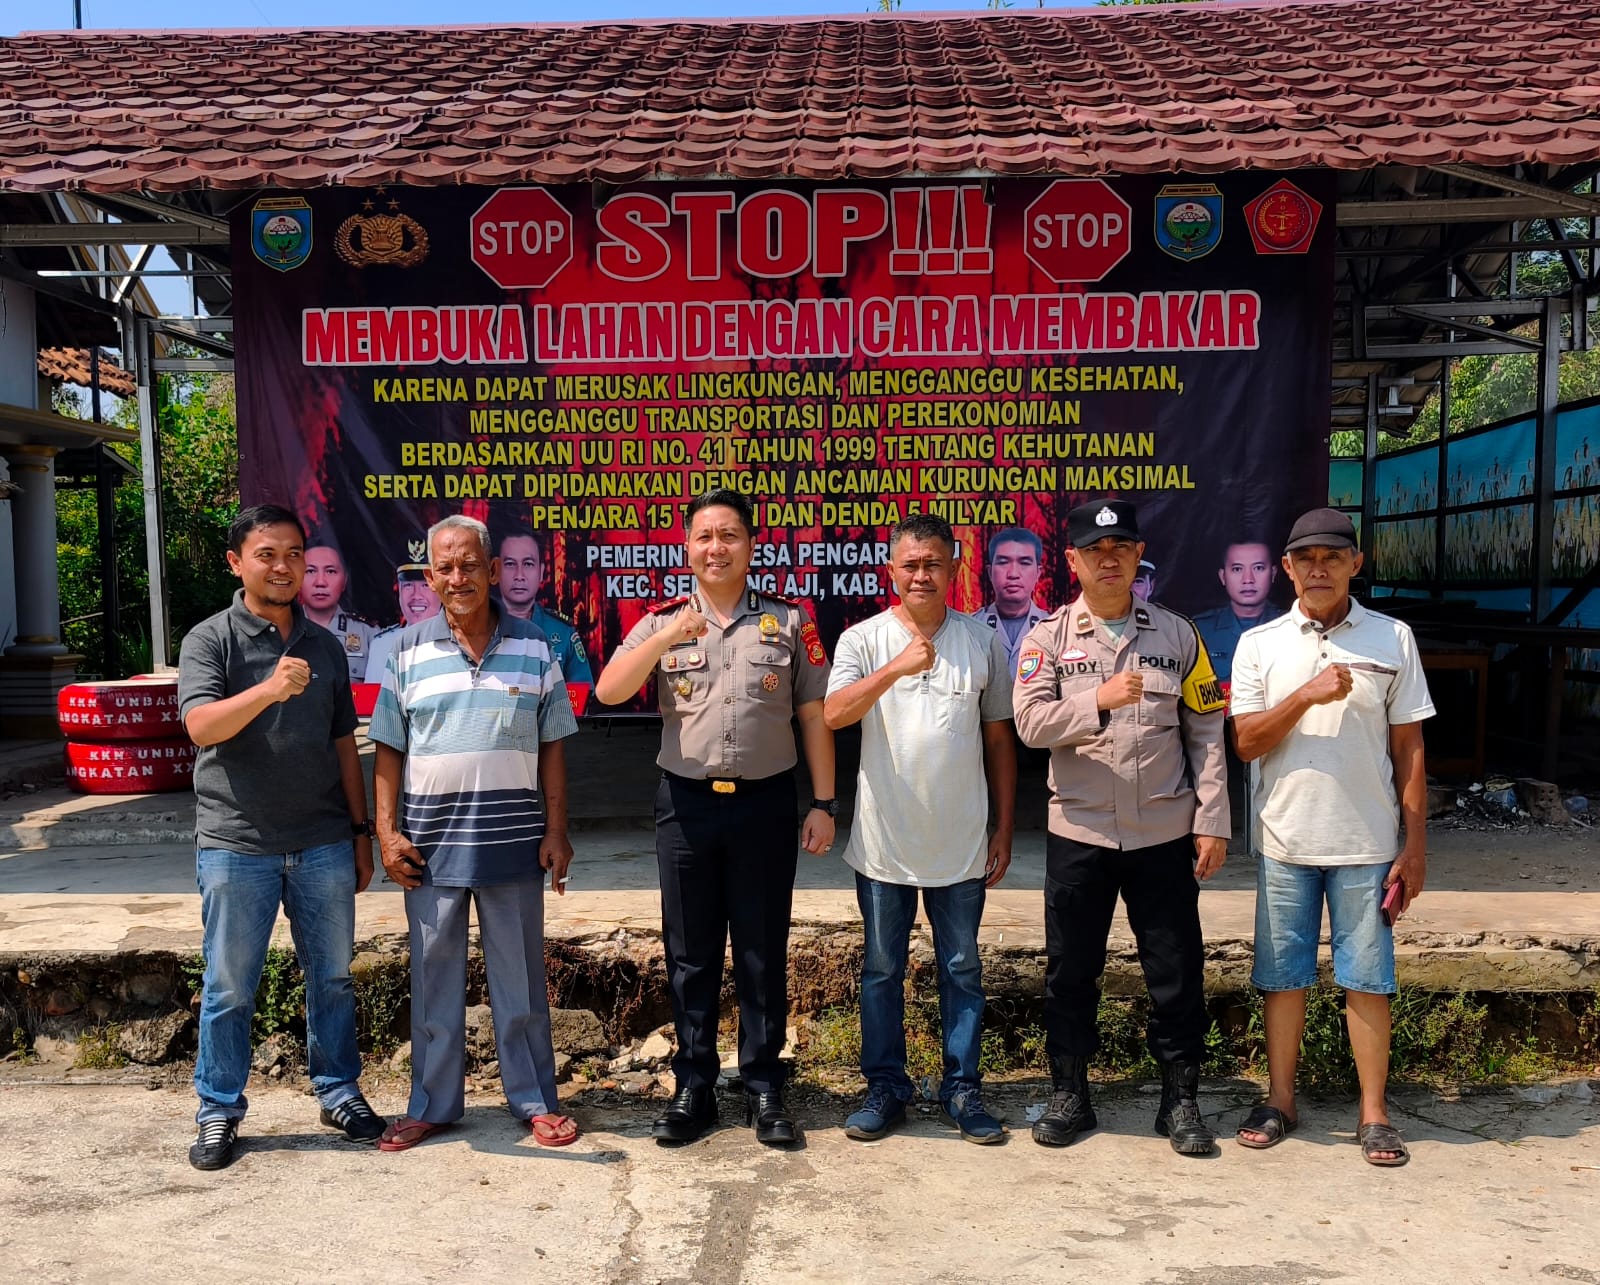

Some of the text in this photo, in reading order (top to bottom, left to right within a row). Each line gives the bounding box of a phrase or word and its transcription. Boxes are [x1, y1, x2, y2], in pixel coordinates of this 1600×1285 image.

[479, 220, 565, 256] STOP
[596, 185, 993, 282] STOP!!!
[1032, 212, 1123, 249] STOP
[302, 290, 1260, 366] MEMBUKA LAHAN DENGAN CARA MEMBAKAR
[373, 366, 1185, 402] KARENA DAPAT MERUSAK LINGKUNGAN, MENGGANGGU KESEHATAN,
[470, 401, 1080, 433] MENGGANGGU TRANSPORTASI DAN PEREKONOMIAN
[401, 434, 1154, 466] BERDASARKAN UU RI NO. 41 TAHUN 1999 TENTANG KEHUTANAN
[364, 466, 1195, 499] SERTA DAPAT DIPIDANAKAN DENGAN ANCAMAN KURUNGAN MAKSIMAL
[532, 505, 639, 529] PENJARA
[648, 505, 673, 528] 15
[767, 503, 813, 527] DAN
[823, 501, 900, 526] DENDA
[928, 500, 1016, 525] MILYAR
[586, 545, 692, 568] PEMERIN
[749, 543, 791, 567] ESA
[606, 575, 657, 598] KEC.
[784, 573, 825, 601] AJI,
[832, 572, 885, 596] KAB.
[1056, 660, 1097, 678] RUDY
[1138, 655, 1181, 673] POLRI
[69, 696, 97, 708] KKN
[60, 711, 143, 726] ANGKATAN
[90, 749, 124, 761] KKN
[66, 765, 153, 779] ANGKATAN
